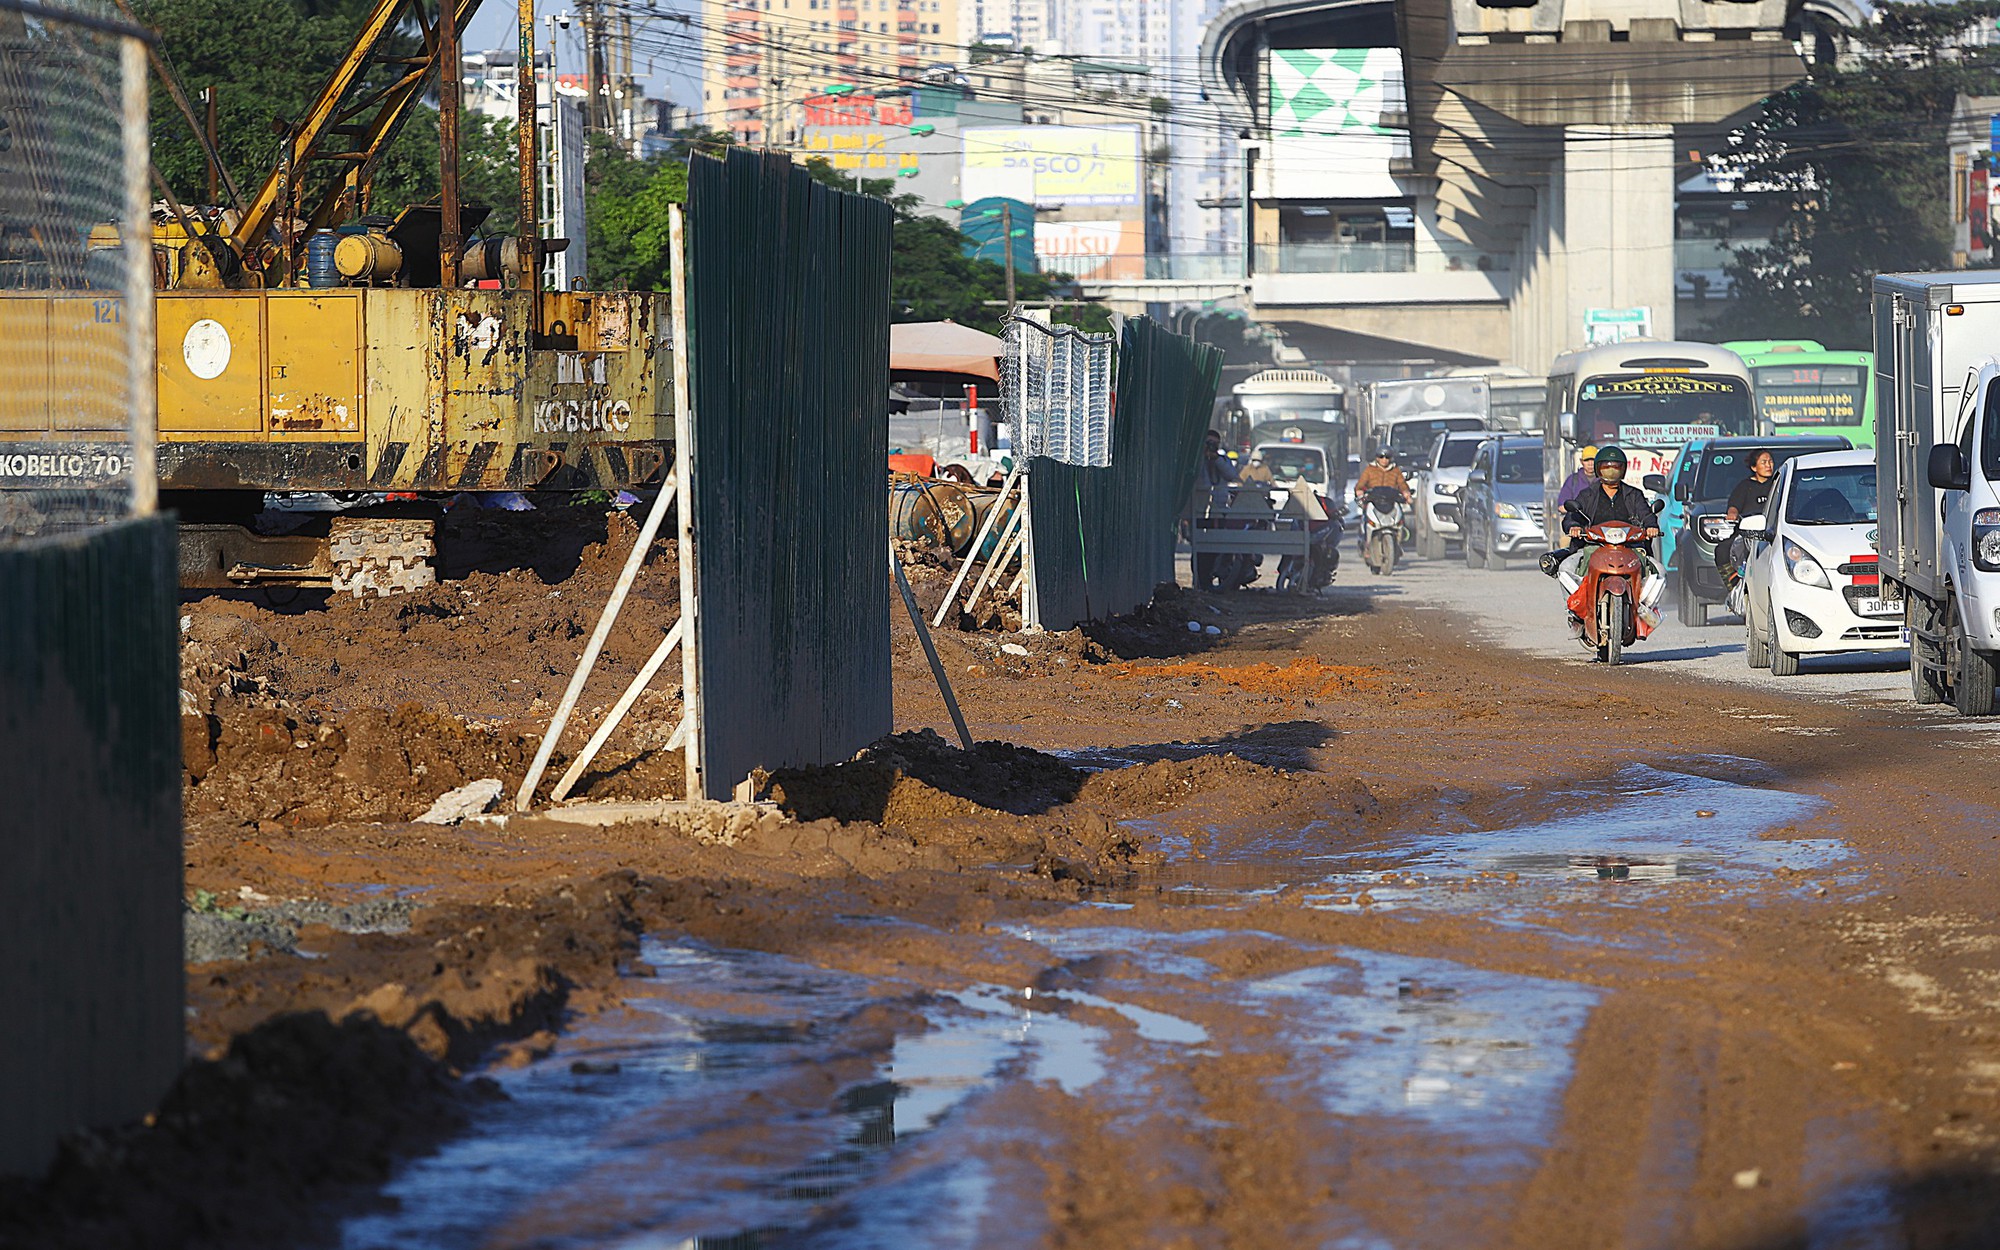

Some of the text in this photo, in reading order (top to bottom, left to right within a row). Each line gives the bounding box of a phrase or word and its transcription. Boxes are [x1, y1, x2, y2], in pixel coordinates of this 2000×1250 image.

[92, 300, 121, 323] 121
[1793, 369, 1820, 383] 114
[1597, 382, 1734, 393] LIMOUSINE
[1669, 426, 1685, 435] CAO
[1687, 426, 1714, 435] PHONG
[1650, 456, 1673, 475] Ng
[1867, 600, 1904, 612] 30M-8
